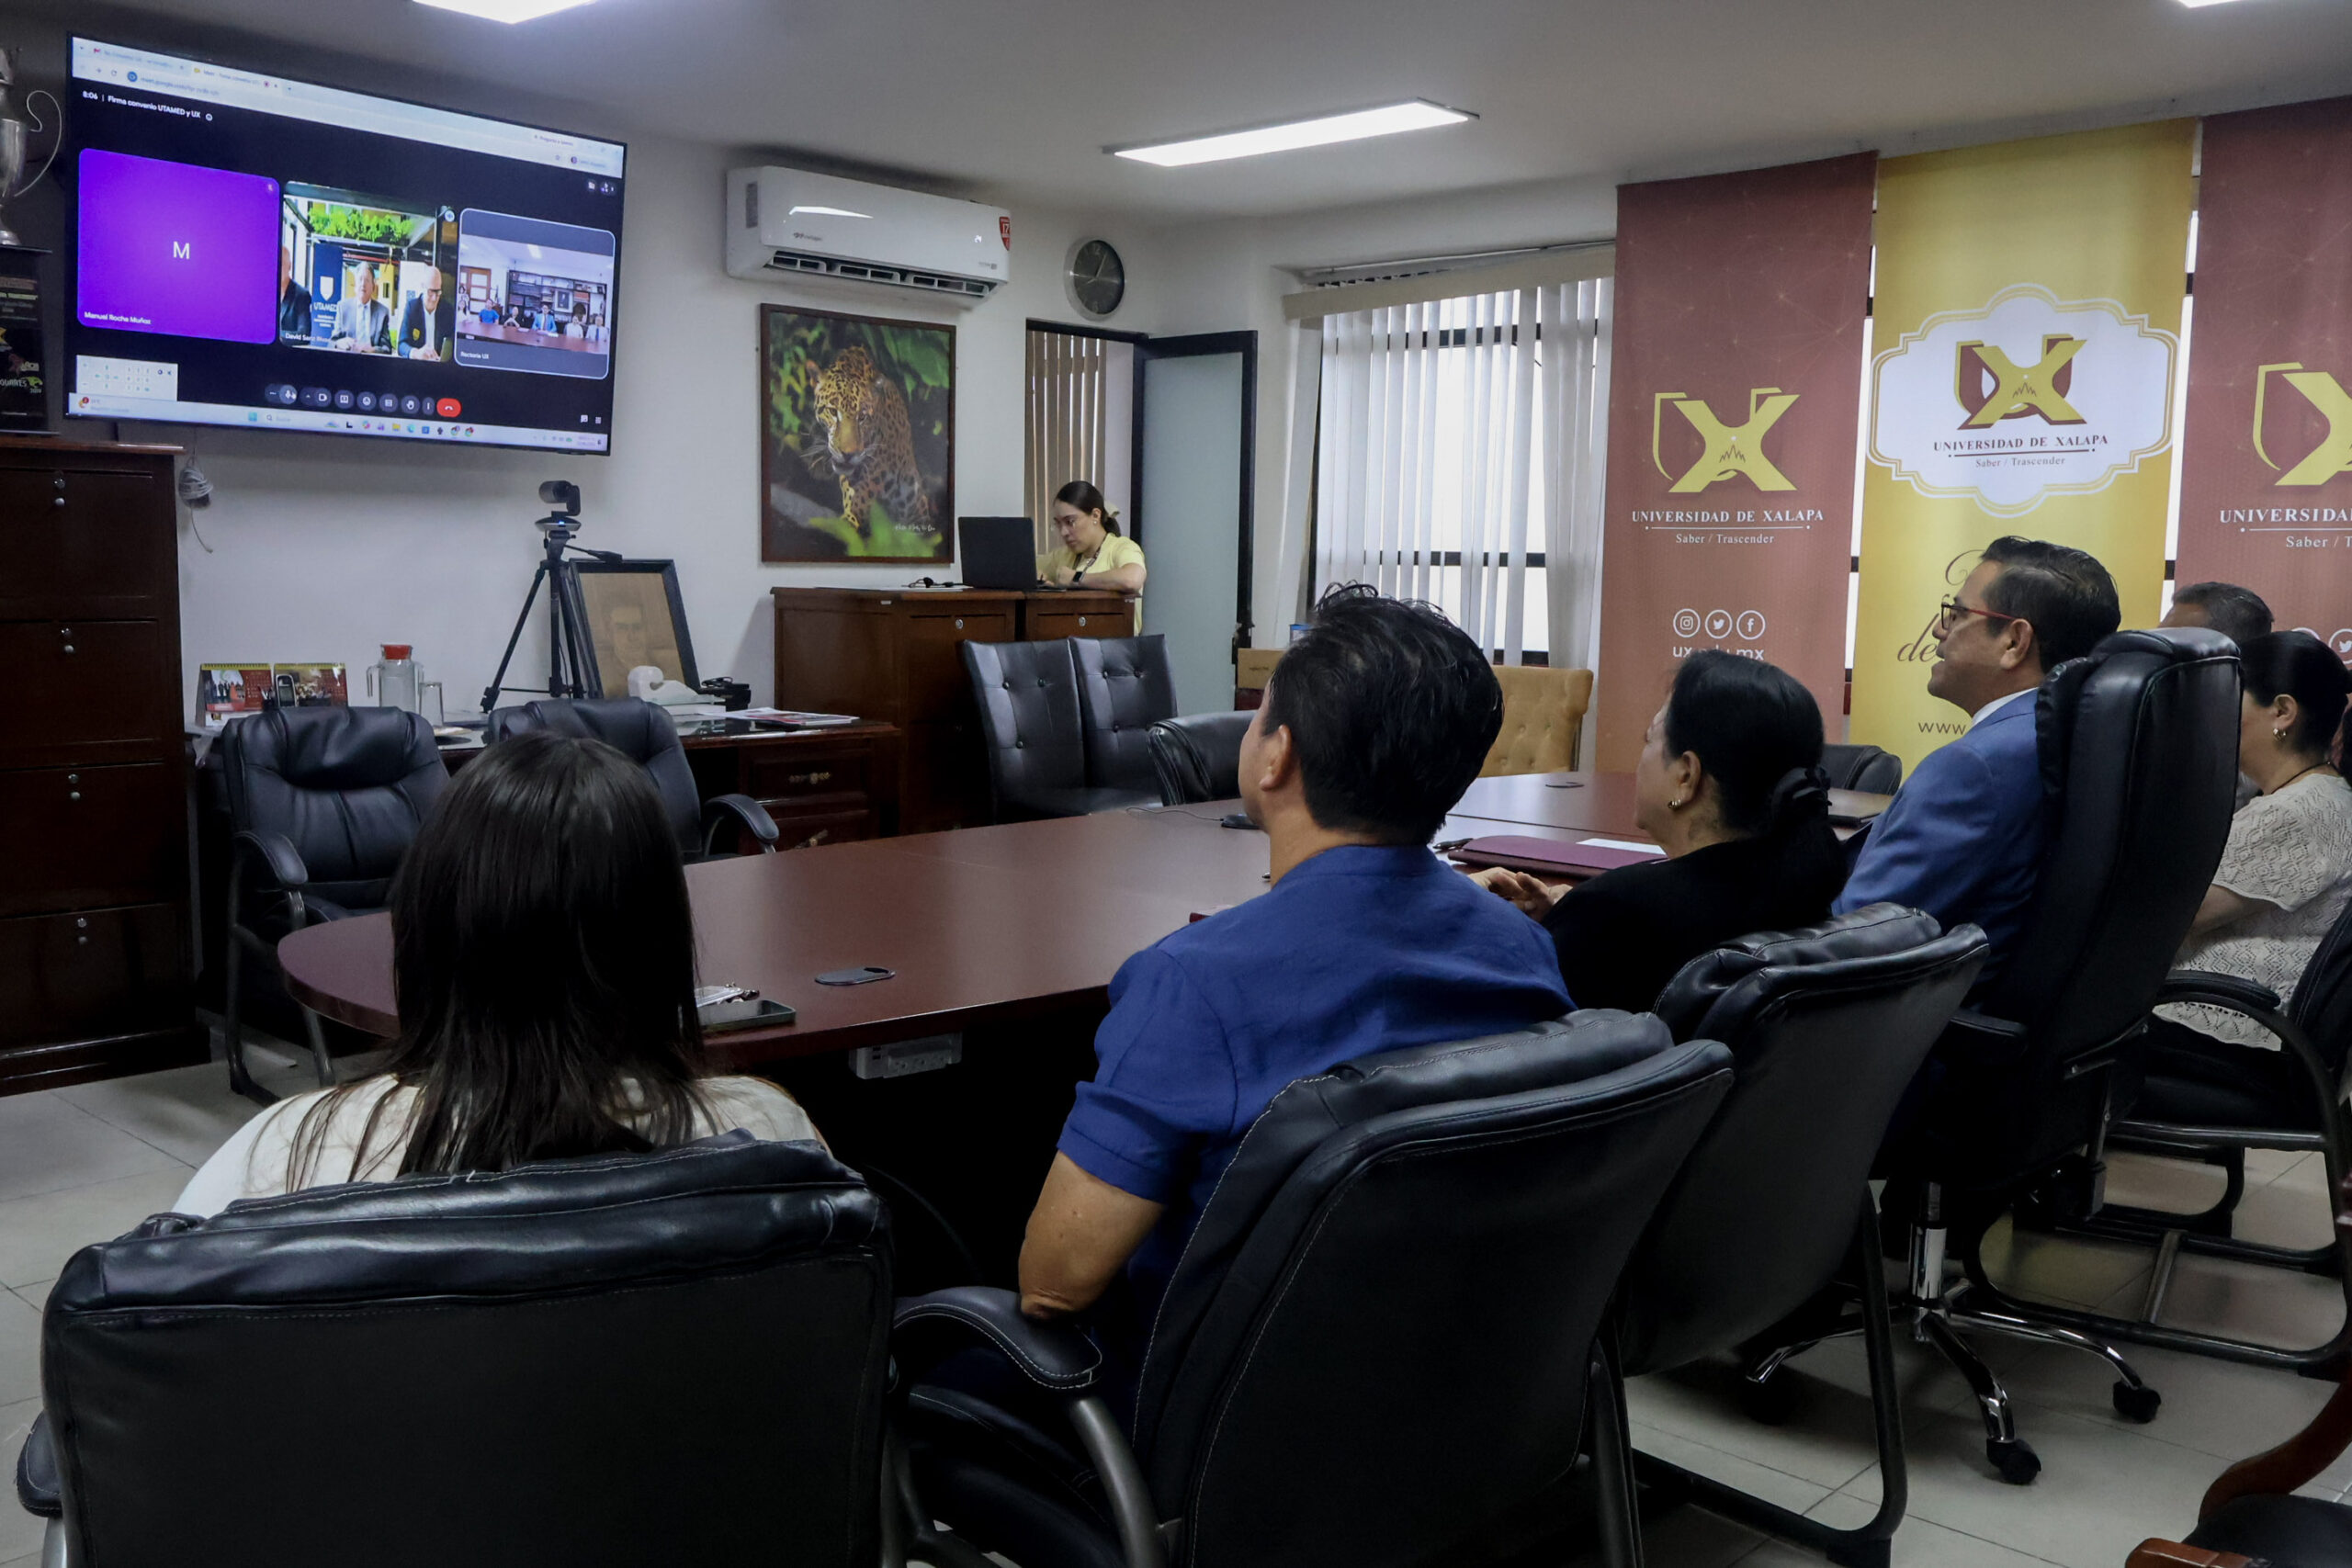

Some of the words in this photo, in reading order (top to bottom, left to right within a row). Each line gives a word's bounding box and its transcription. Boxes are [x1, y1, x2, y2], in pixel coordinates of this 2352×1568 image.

[107, 96, 127, 106] Firma
[128, 100, 157, 110] convenio
[157, 105, 185, 116] UTAMED
[191, 109, 201, 118] UX
[173, 242, 190, 260] M
[84, 311, 108, 321] Manuel
[1934, 437, 2023, 452] UNIVERSIDAD
[2030, 436, 2048, 447] DE
[2055, 434, 2109, 447] XALAPA
[1975, 459, 2001, 468] Saber
[2012, 457, 2066, 468] Trascender
[1632, 510, 1730, 523] UNIVERSIDAD
[1736, 510, 1756, 523] DE
[1763, 509, 1825, 523] XALAPA
[2220, 508, 2352, 524] UNIVERSIDA
[1676, 534, 1705, 544] Saber
[1716, 533, 1775, 545] Trascender
[2286, 536, 2328, 548] Saber
